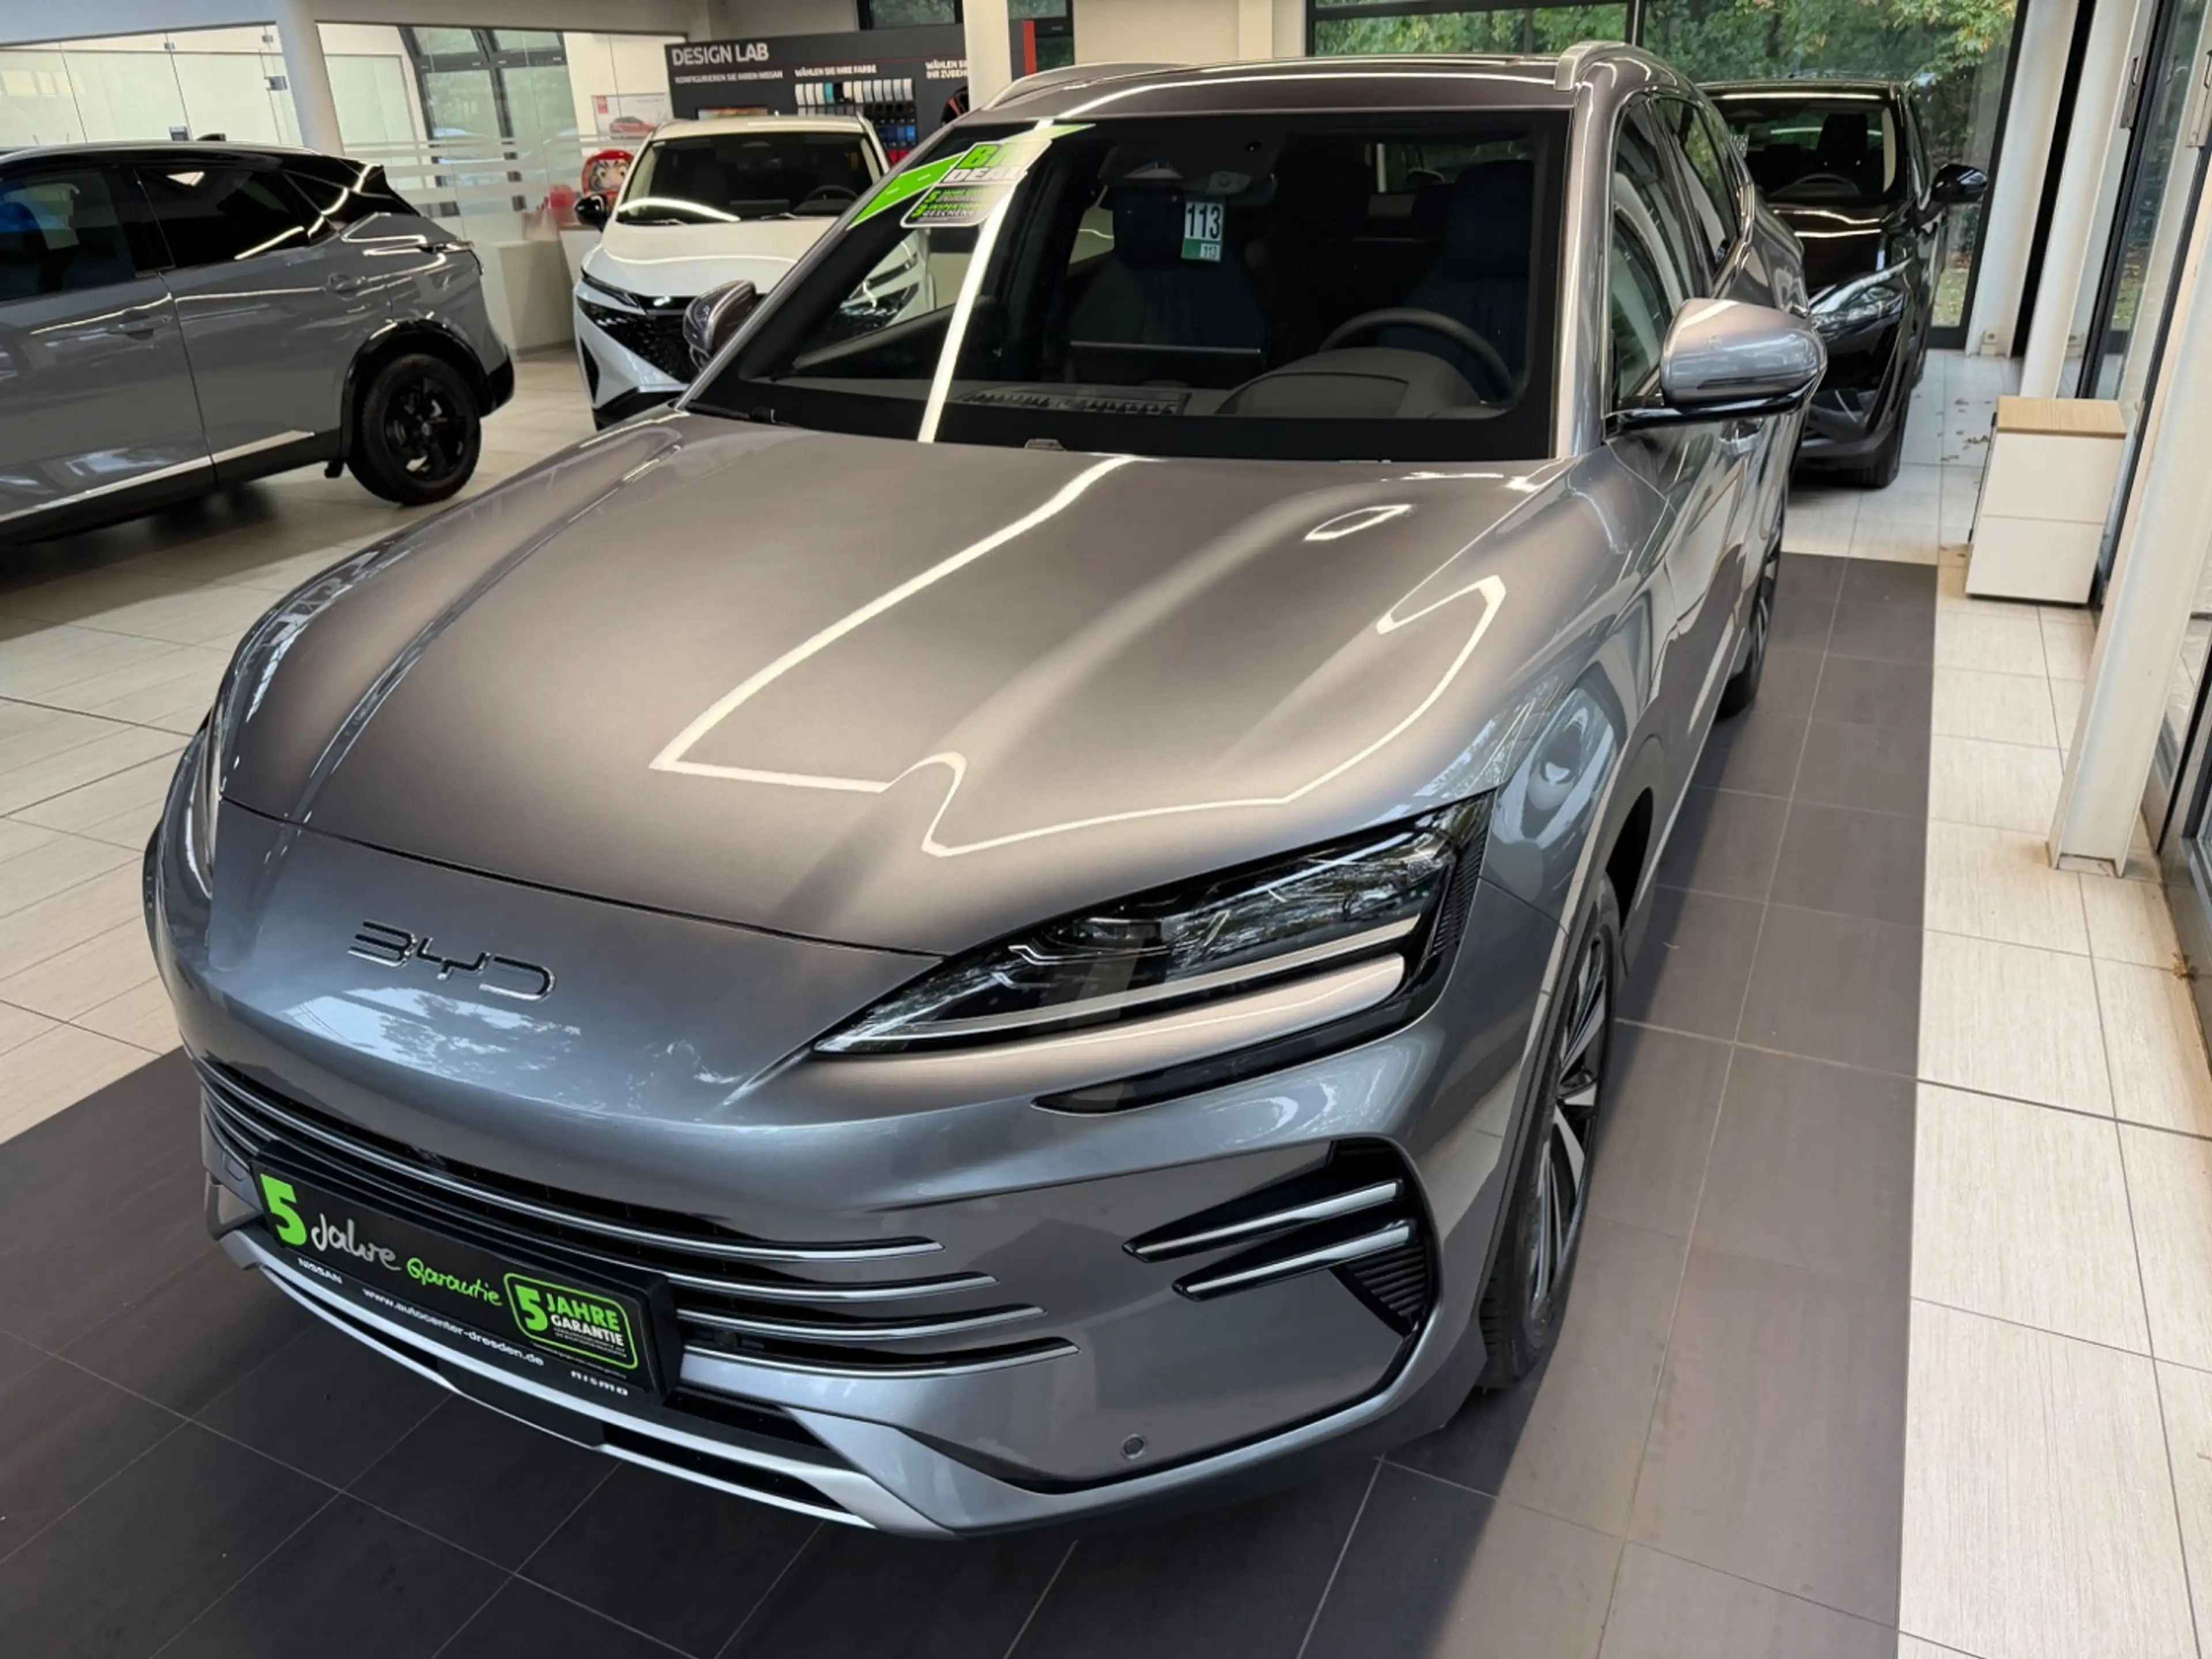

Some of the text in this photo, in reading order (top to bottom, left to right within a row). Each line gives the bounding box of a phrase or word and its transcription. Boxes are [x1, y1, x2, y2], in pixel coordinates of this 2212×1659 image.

[671, 42, 770, 66] DESIGN LAB
[794, 63, 877, 78] WÄHLEN SIE IHRE FARBE
[726, 72, 737, 82] SIE
[1187, 202, 1221, 240] 113
[347, 919, 556, 1003] BYD
[260, 1173, 503, 1306] 5 Jahre Garantie
[297, 1257, 343, 1285] NISSAN
[514, 1284, 620, 1332] 5 JAHRE
[362, 1287, 544, 1367] www.autocenter-dresden.de
[550, 1314, 625, 1347] GARANTIE
[570, 1370, 628, 1397] nismo
